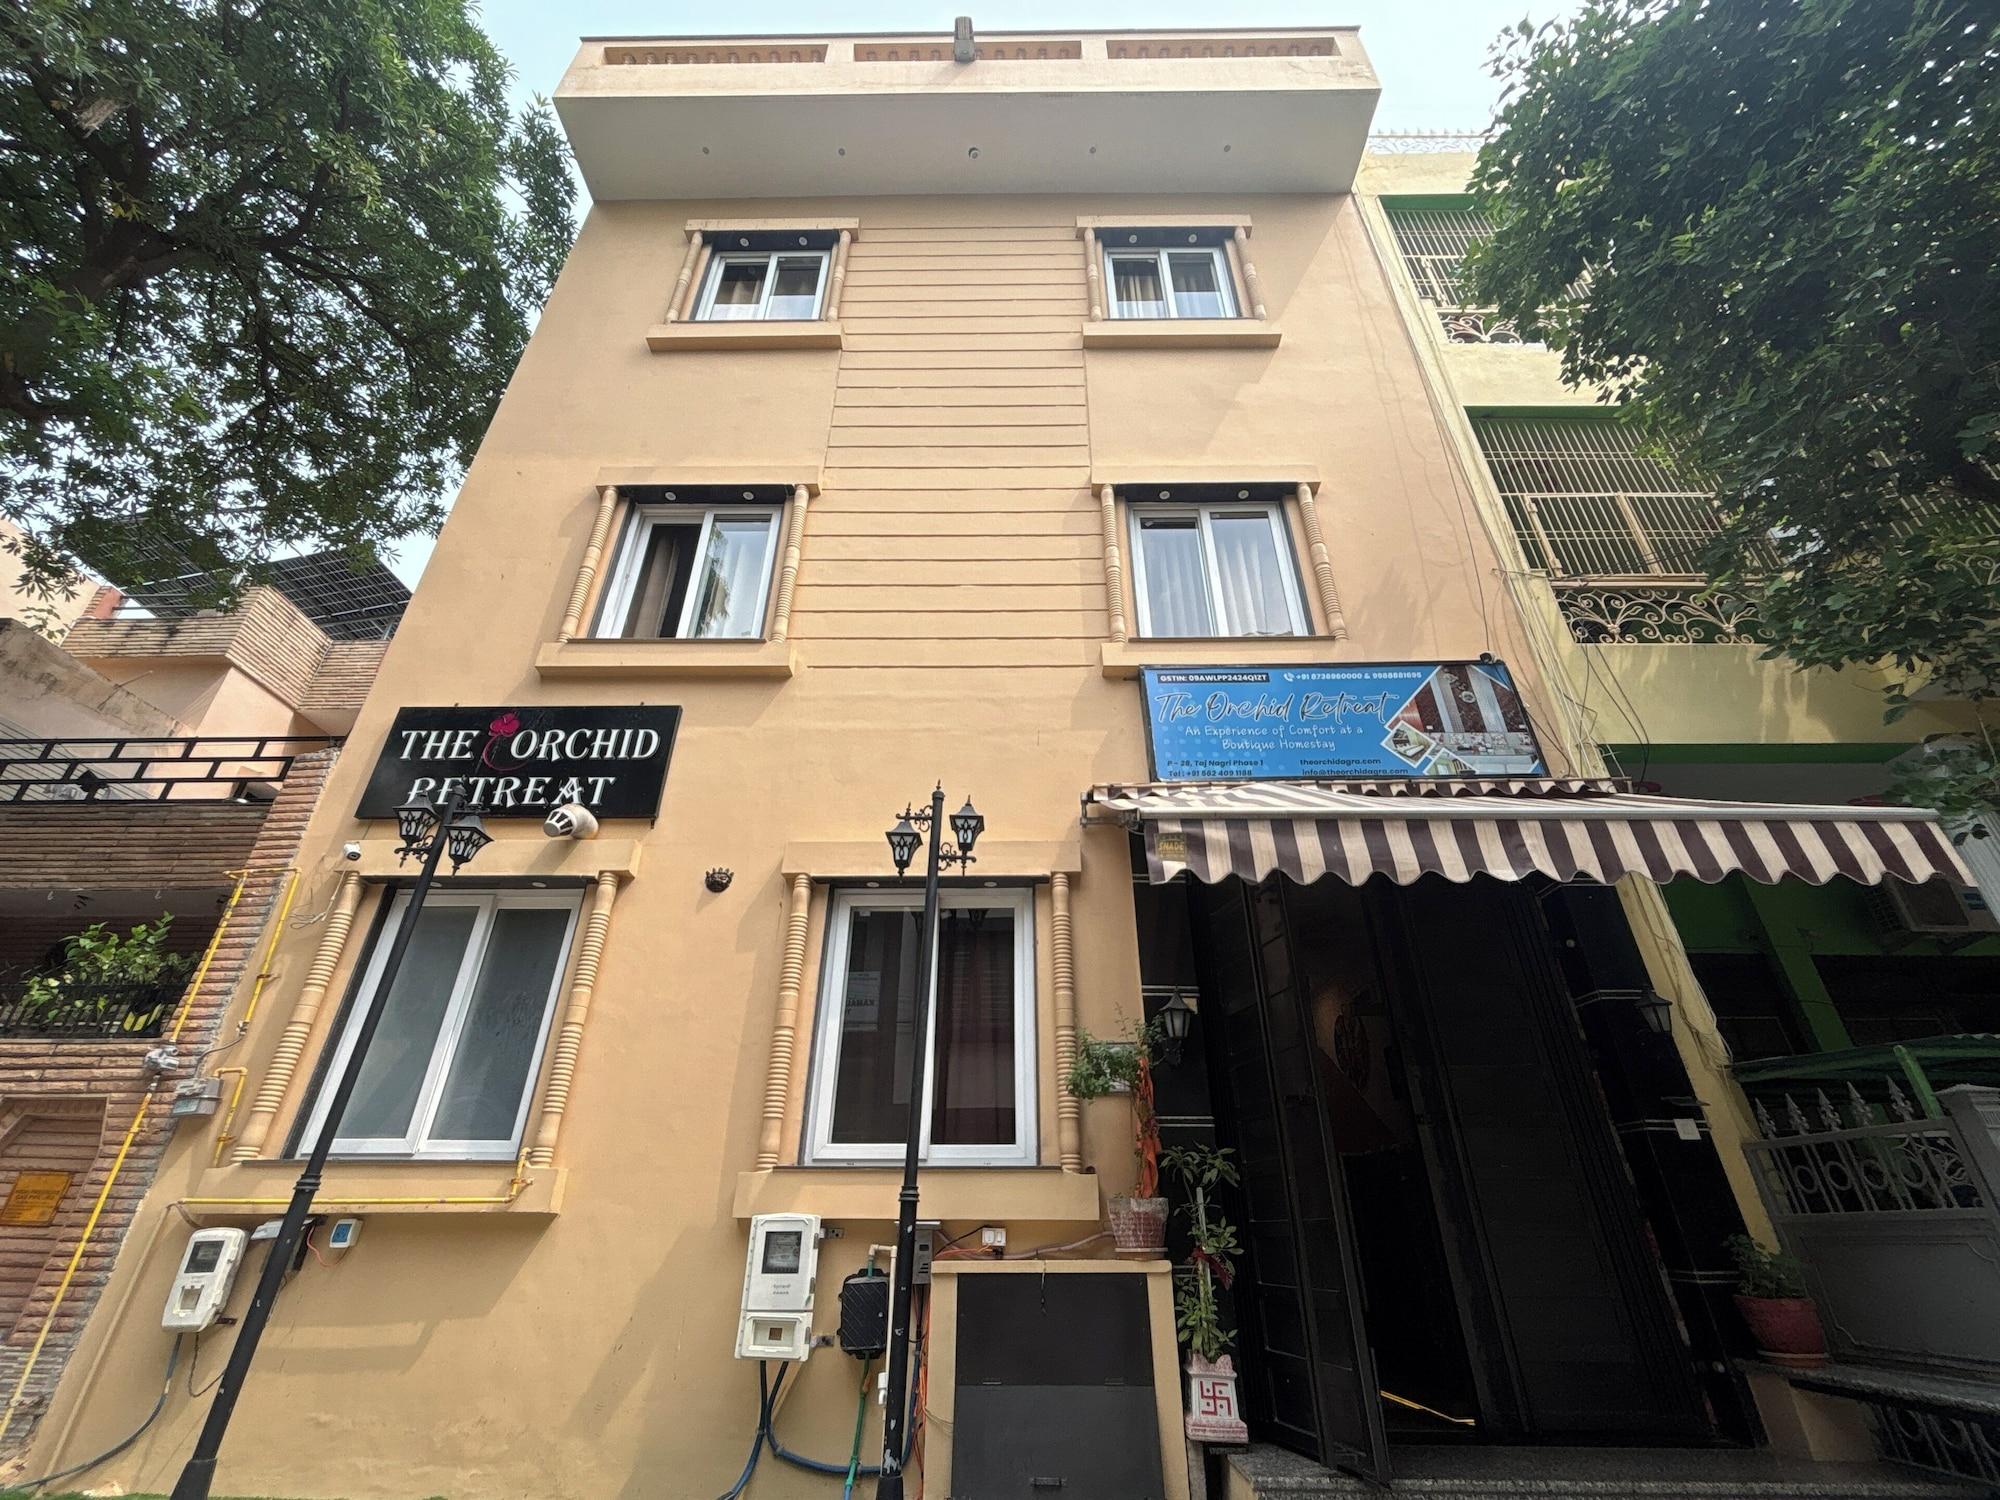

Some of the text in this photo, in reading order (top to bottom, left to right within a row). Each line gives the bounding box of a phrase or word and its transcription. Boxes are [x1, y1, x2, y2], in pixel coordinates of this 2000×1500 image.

[1156, 691, 1400, 724] The Orchid Retreat
[1185, 726, 1200, 736] An
[1204, 726, 1268, 738] Experience
[1272, 726, 1284, 738] of
[1289, 725, 1336, 738] Comfort
[1340, 725, 1352, 734] at
[400, 728, 660, 762] THE ORCHID
[1222, 738, 1336, 752] Boutique Homestay
[1195, 760, 1206, 768] Taj
[1208, 760, 1232, 768] Nagri
[1300, 758, 1381, 766] theorchidagra.com
[406, 776, 616, 808] RETREAT
